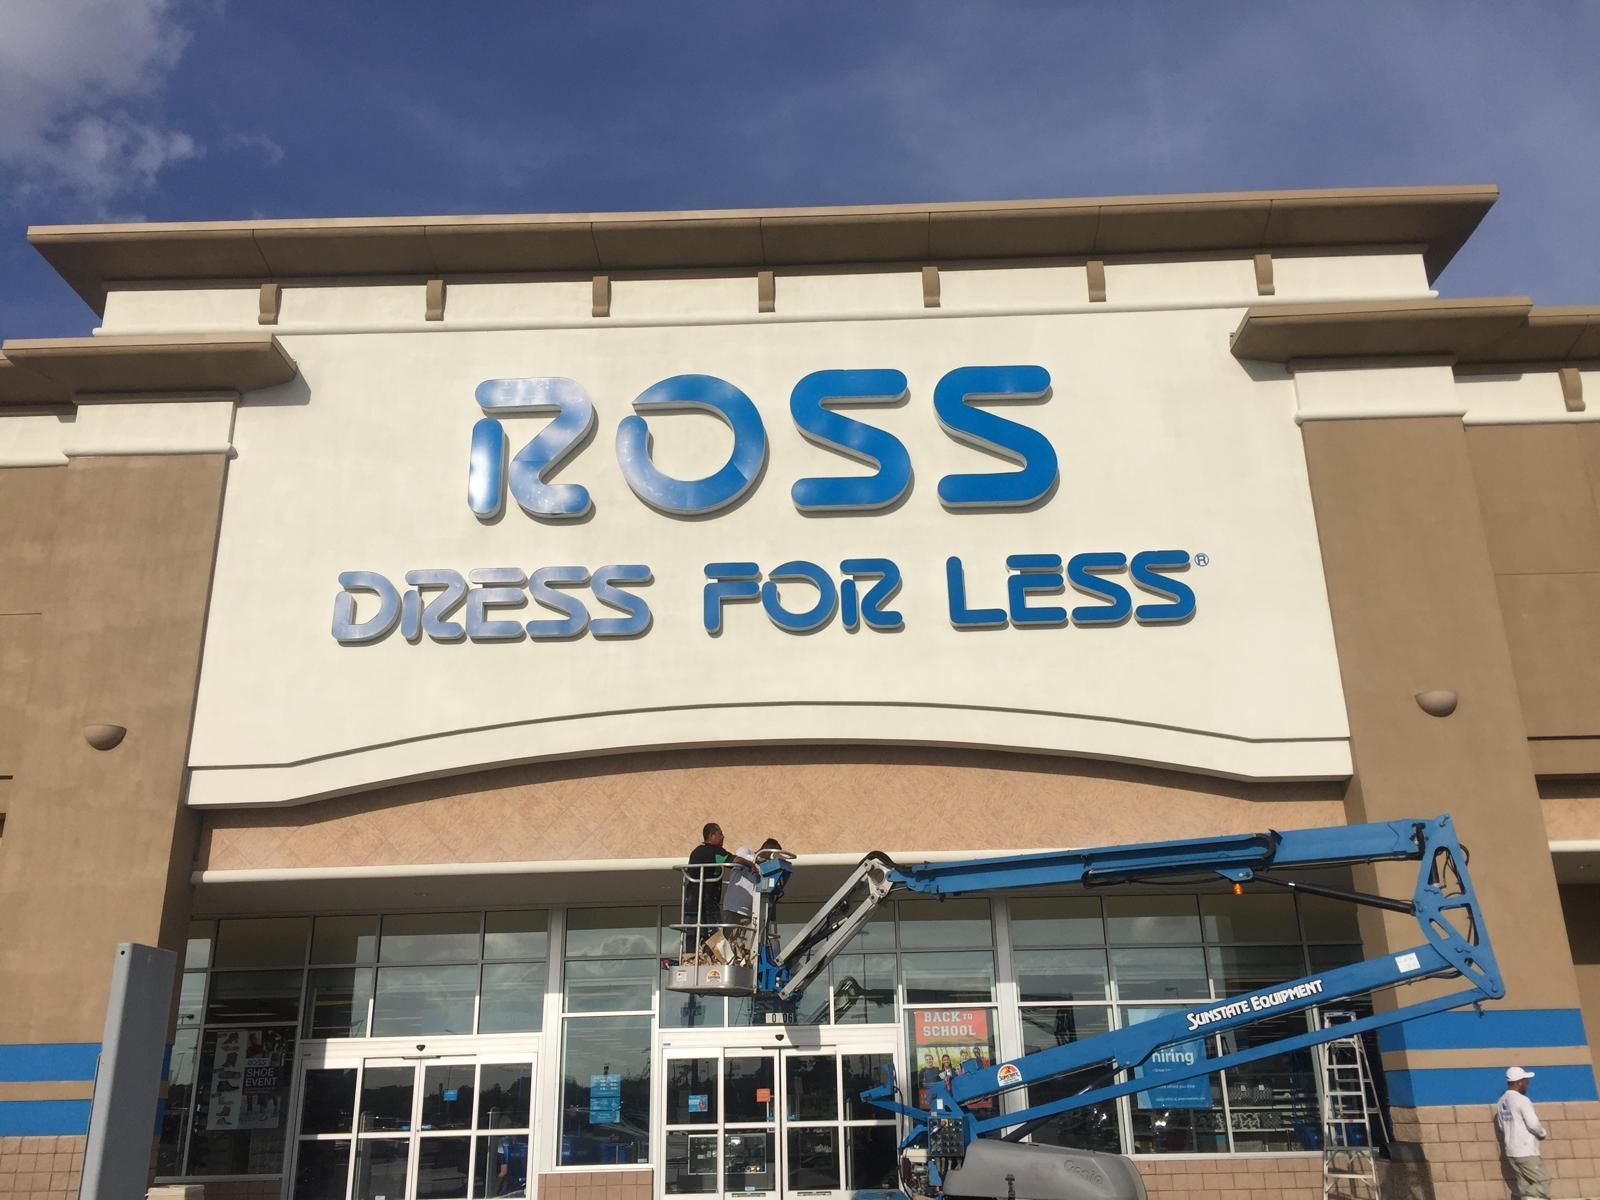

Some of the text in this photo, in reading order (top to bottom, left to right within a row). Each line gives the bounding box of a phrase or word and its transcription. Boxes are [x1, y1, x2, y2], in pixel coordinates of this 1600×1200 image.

[466, 365, 1060, 519] ROSS
[332, 564, 653, 643] DRESS
[703, 557, 904, 634] FOR
[946, 550, 1196, 628] LESS
[1186, 979, 1323, 1031] SUNSTATE EQUIPMENT
[924, 1011, 961, 1022] BACK
[923, 1024, 977, 1036] SCHOOL
[246, 1067, 275, 1077] SHOE
[244, 1077, 278, 1087] EVENT
